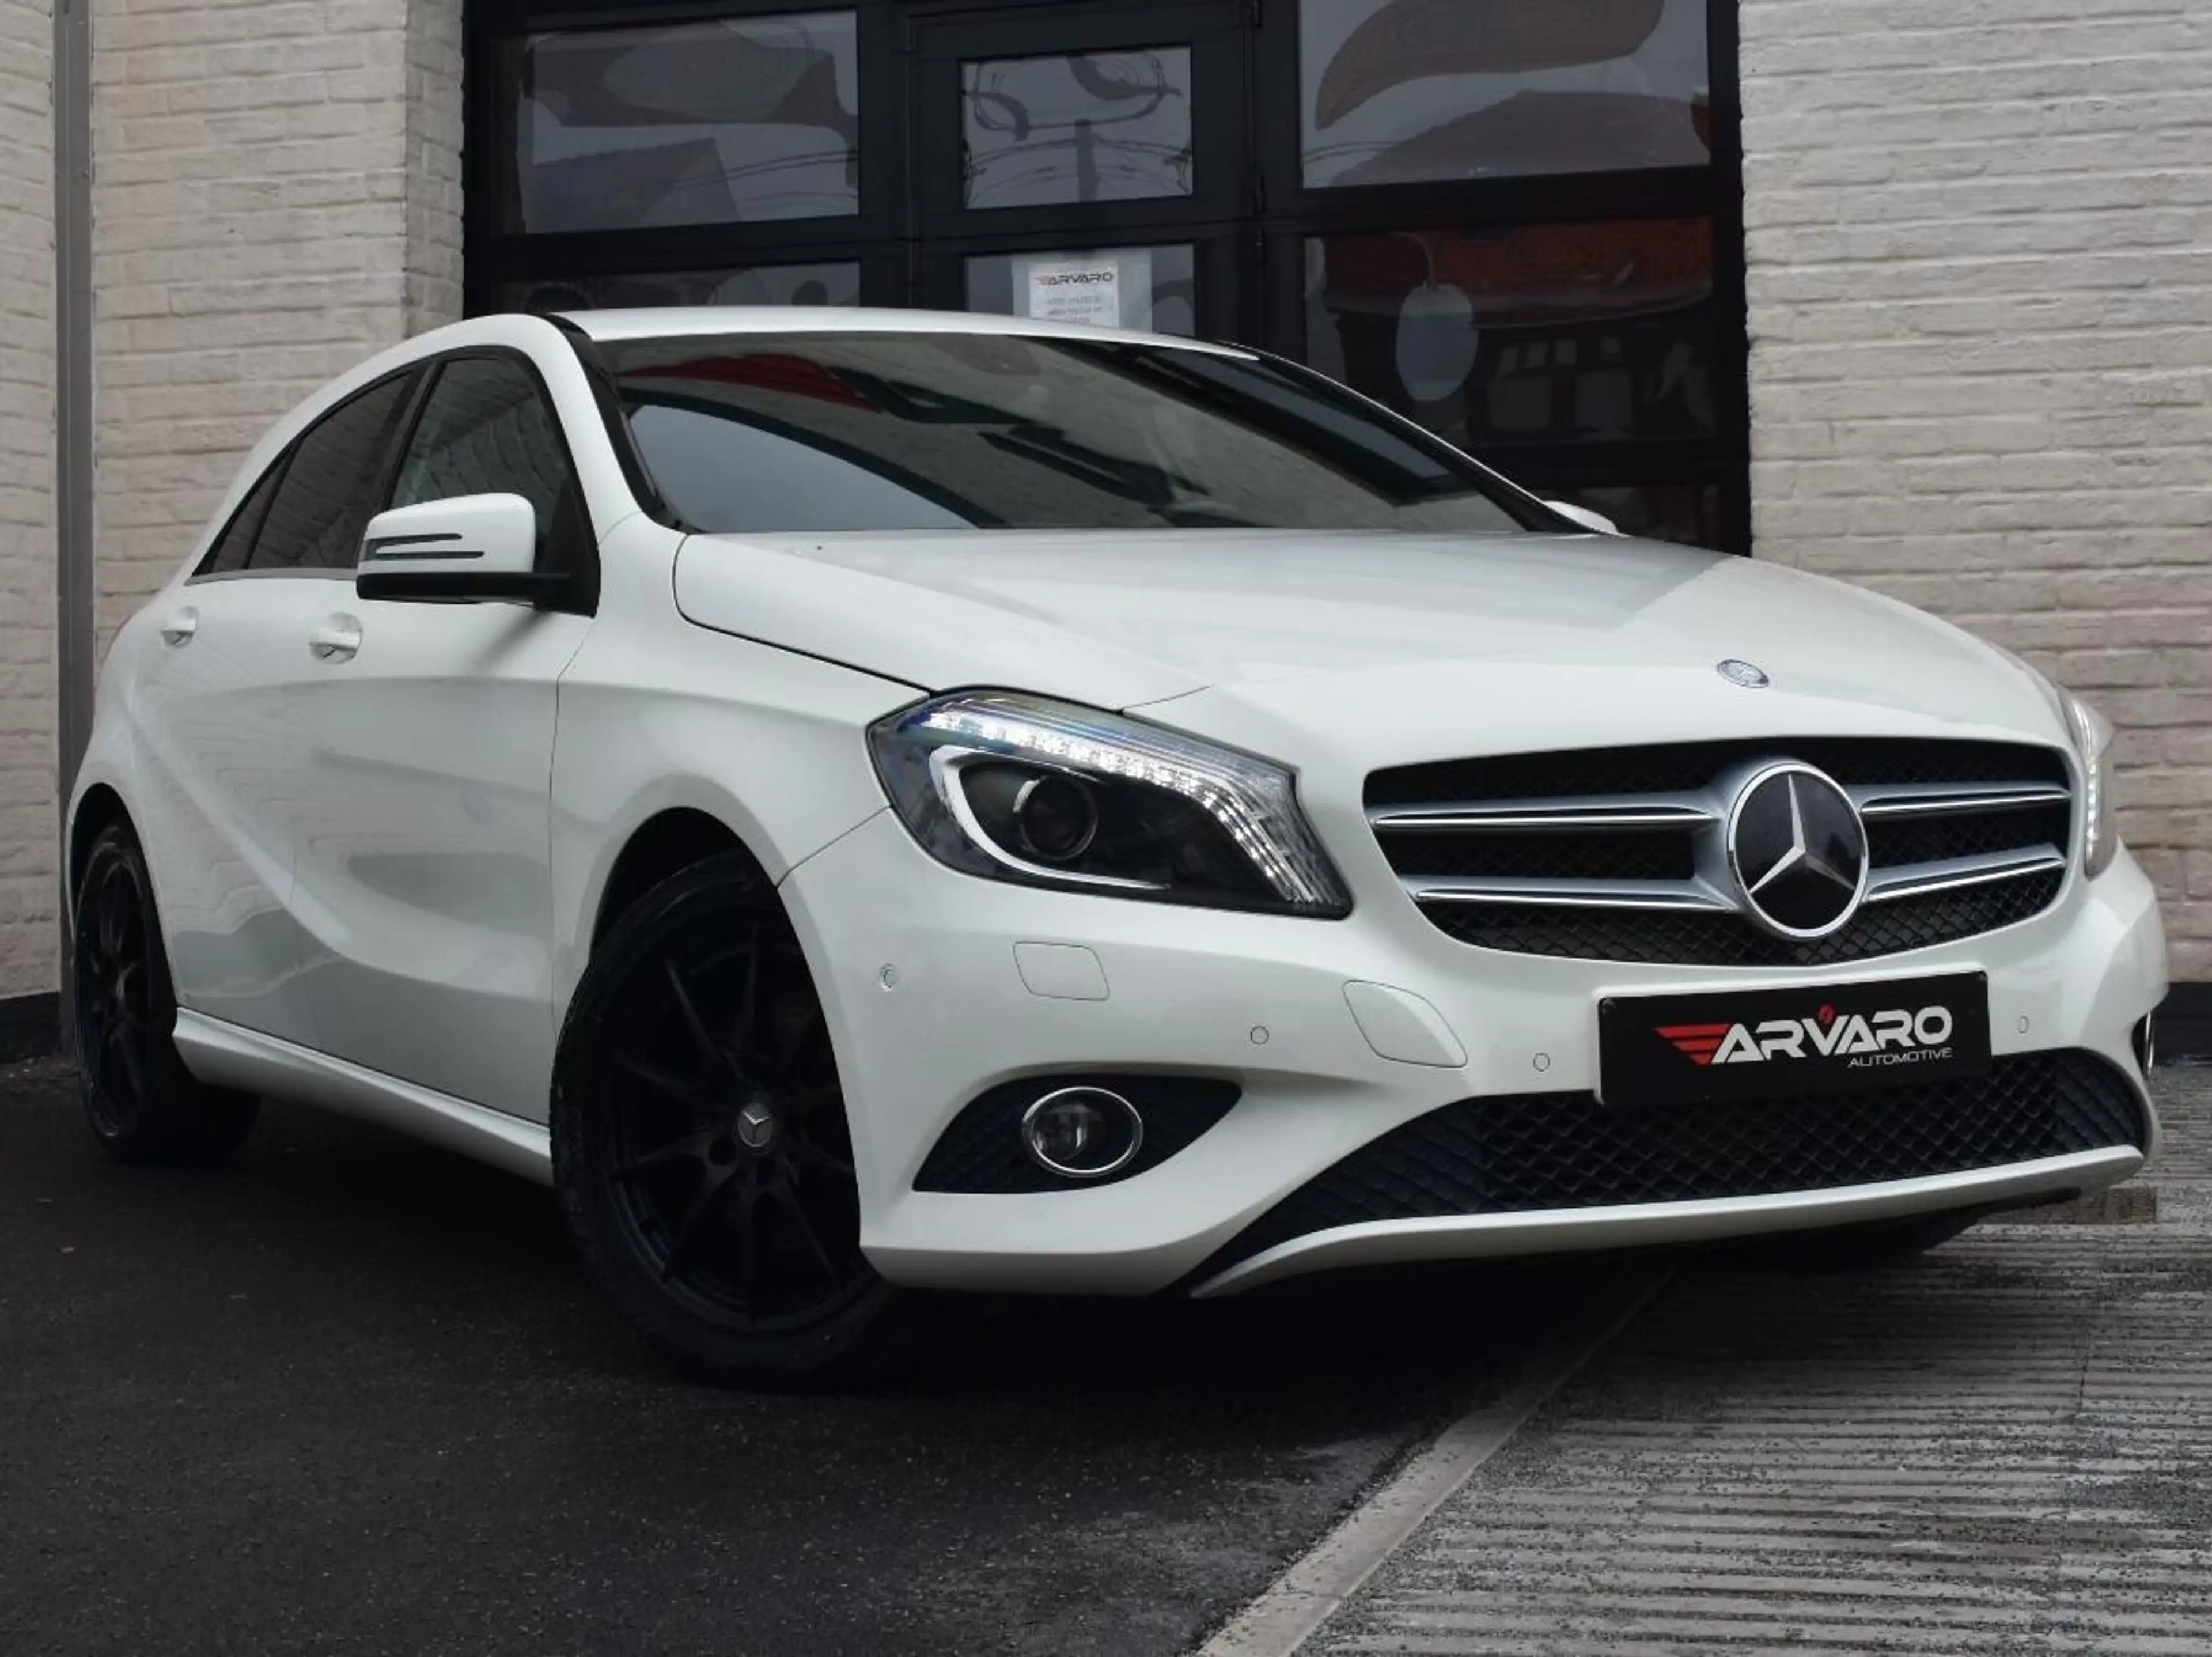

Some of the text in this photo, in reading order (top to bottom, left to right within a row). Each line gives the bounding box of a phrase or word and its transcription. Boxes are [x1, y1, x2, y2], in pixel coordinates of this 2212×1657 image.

[1048, 271, 1113, 285] ARVARO
[1711, 1005, 1952, 1063] ARVARO
[1848, 1047, 1952, 1068] AUTOMOTIVE
